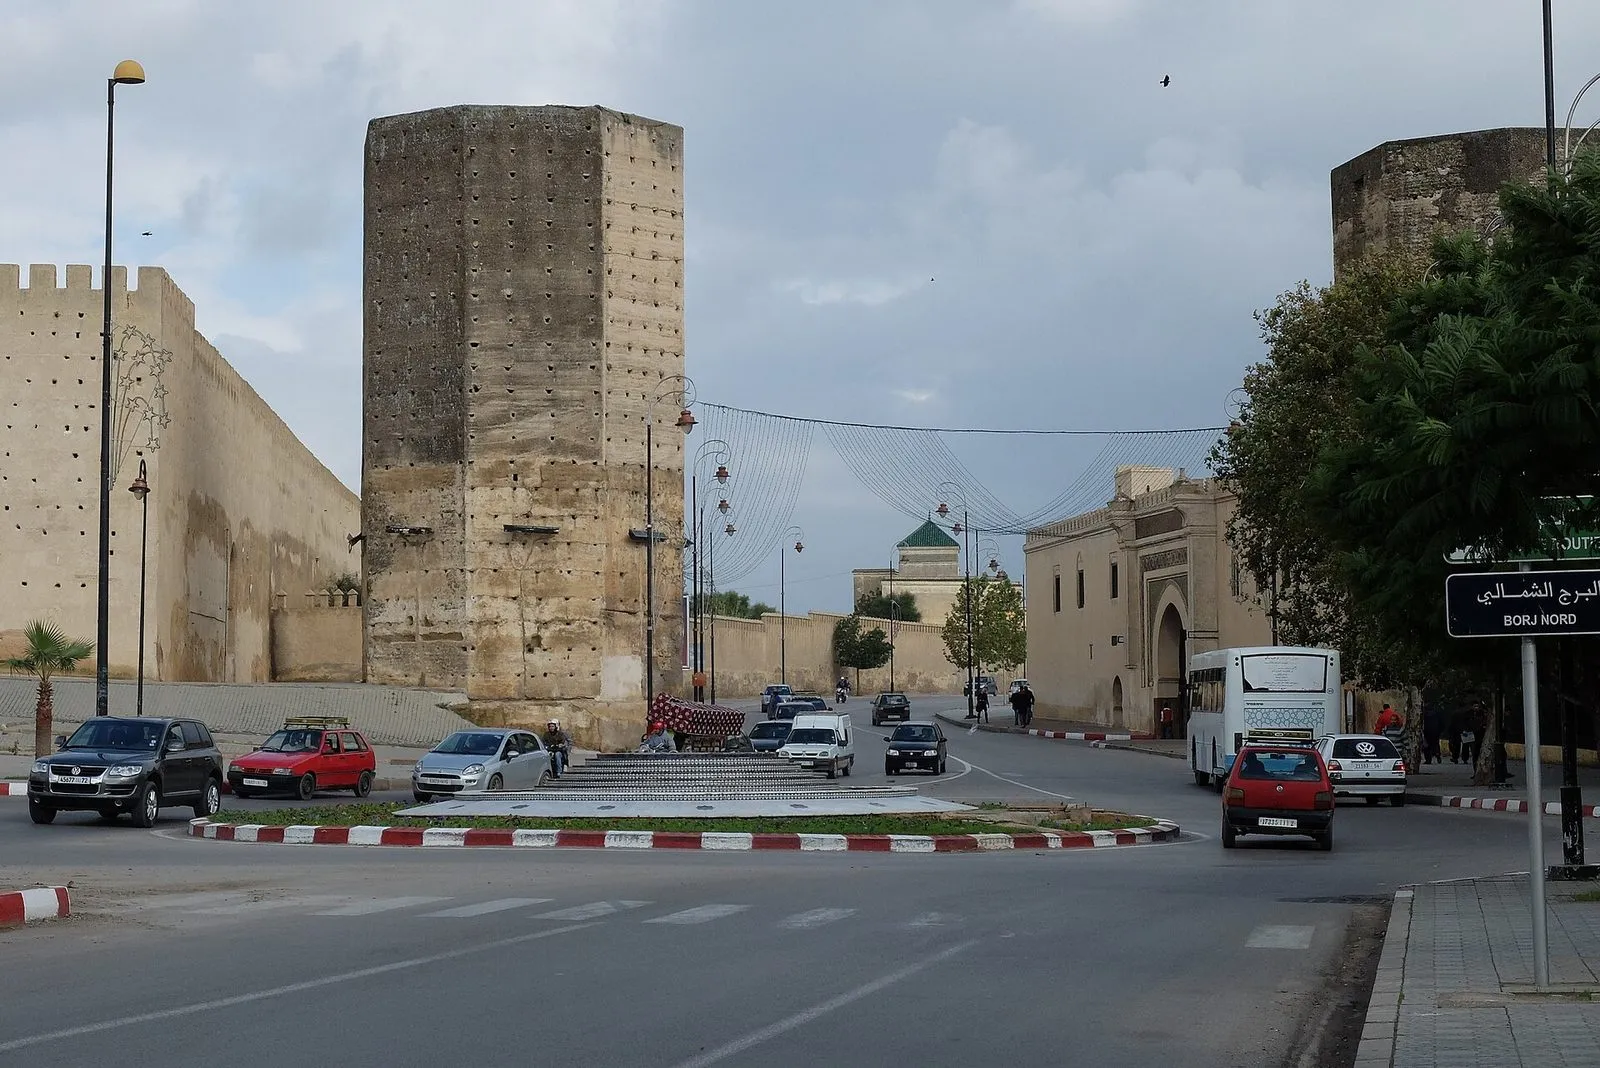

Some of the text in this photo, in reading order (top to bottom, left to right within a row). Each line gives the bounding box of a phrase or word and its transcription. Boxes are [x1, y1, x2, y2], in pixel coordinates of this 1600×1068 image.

[1477, 582, 1554, 606] الشمالي
[1503, 613, 1577, 627] BORJ NORD
